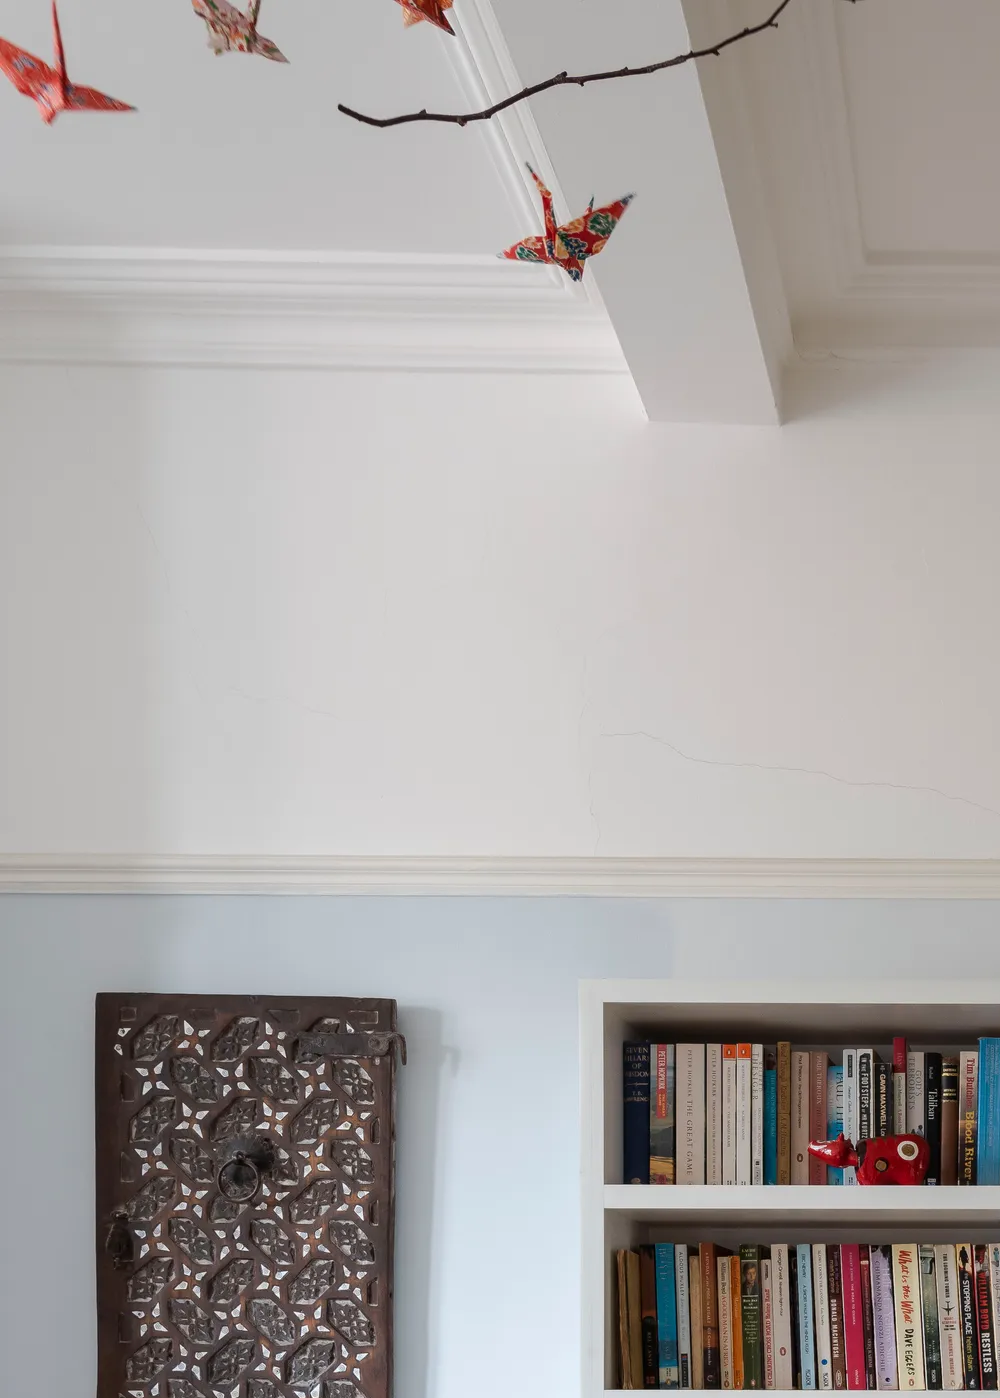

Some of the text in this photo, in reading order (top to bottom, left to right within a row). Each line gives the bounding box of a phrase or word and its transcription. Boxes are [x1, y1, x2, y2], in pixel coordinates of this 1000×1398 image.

[928, 1089, 937, 1120] Taliban
[964, 1058, 974, 1179] Tim Butcher Blood River
